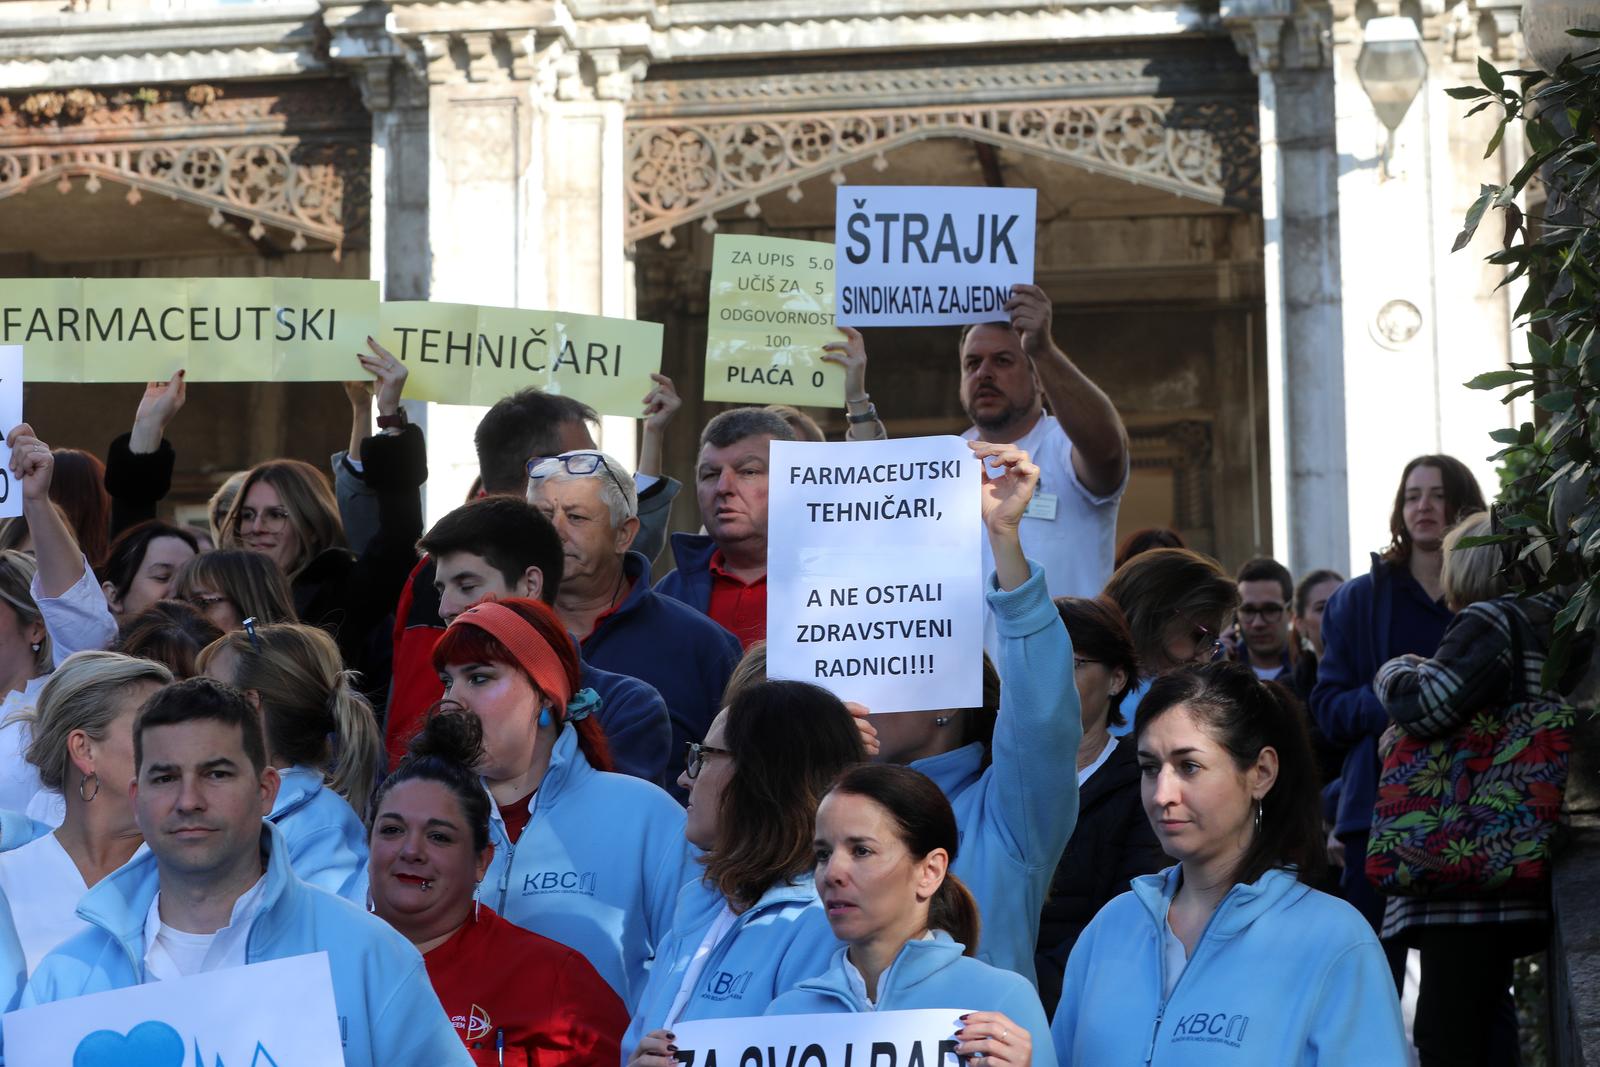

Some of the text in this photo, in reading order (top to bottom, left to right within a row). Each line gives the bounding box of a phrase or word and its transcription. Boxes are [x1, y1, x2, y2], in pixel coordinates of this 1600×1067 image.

[845, 198, 1020, 265] ŠTRAJK
[731, 251, 752, 264] ZA
[758, 252, 795, 267] UPIS
[738, 274, 824, 295] UČIŠ ZA 5
[842, 285, 1012, 315] SINDIKATA ZAJEDN
[3, 307, 336, 342] FARMACEUTSKI
[720, 308, 836, 325] ODGOVORNOST
[393, 328, 621, 377] TEHNIČARI
[765, 335, 792, 348] 100
[727, 364, 824, 388] PLAĆA 0
[790, 460, 961, 485] FARMACEUTSKI
[806, 495, 943, 522] TEHNIČARI,
[806, 583, 942, 607] A NE OSTALI
[796, 618, 952, 643] ZDRAVSTVENI
[815, 654, 934, 678] RADNICI!!!
